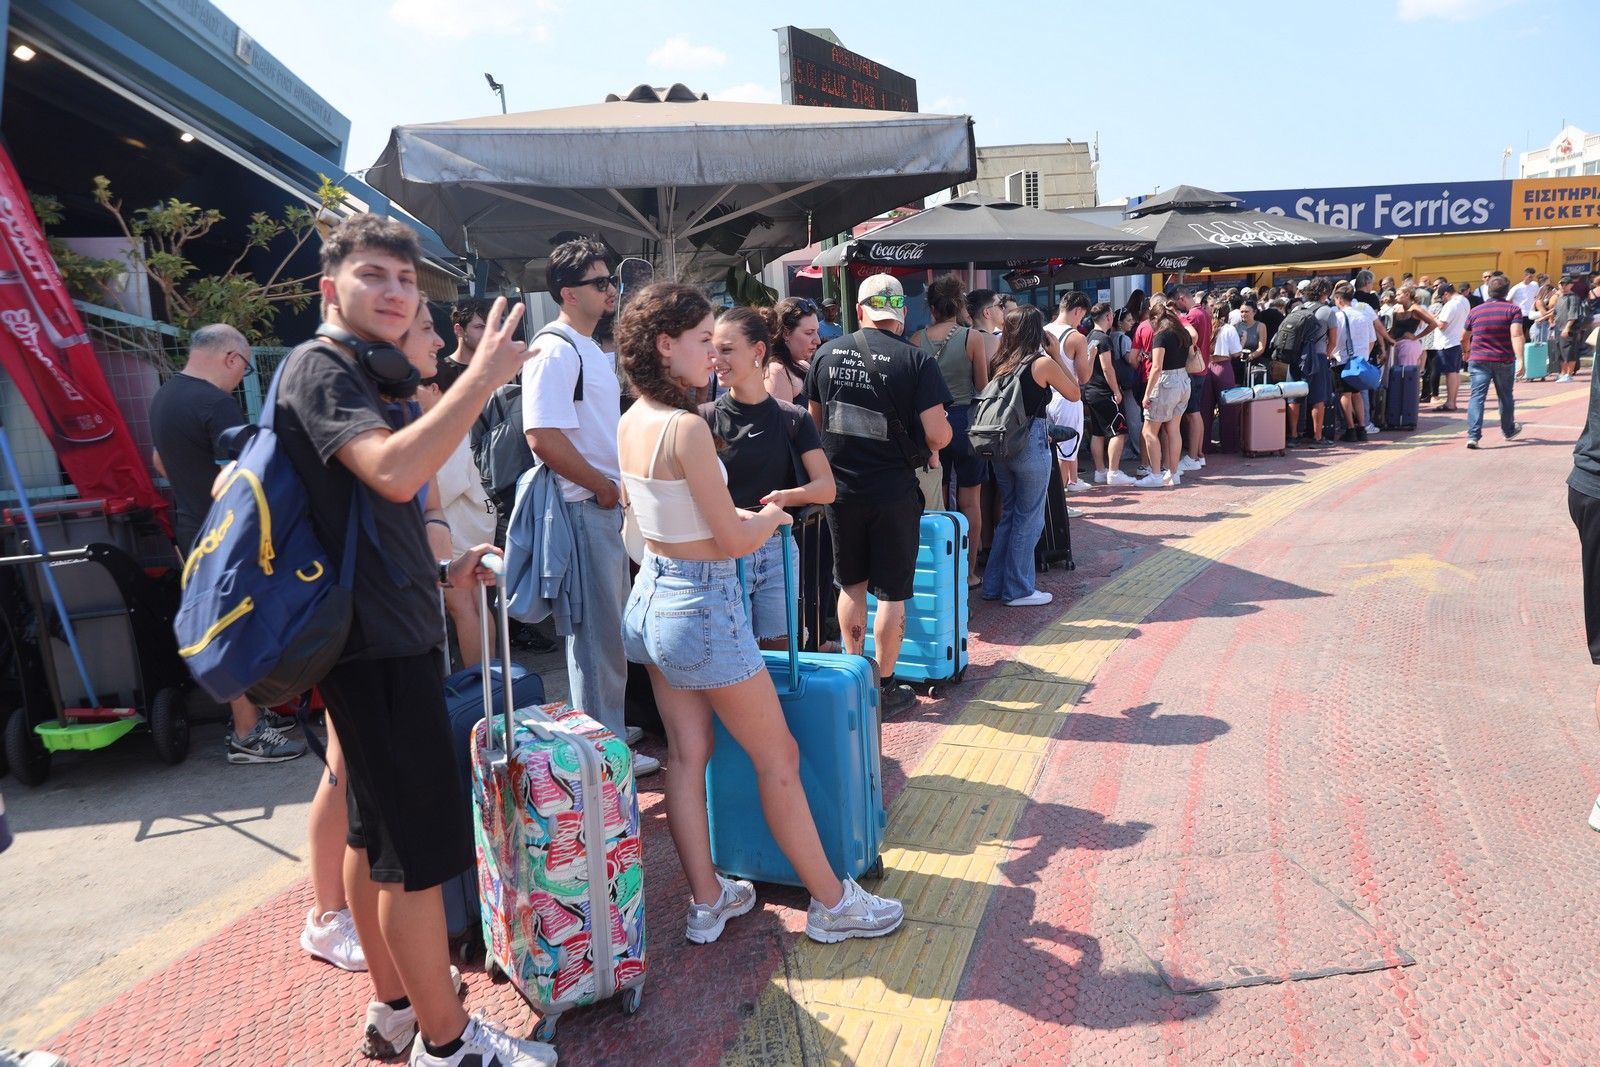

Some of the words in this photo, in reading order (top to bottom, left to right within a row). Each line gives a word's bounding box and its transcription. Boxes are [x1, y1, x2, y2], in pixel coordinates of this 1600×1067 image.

[1296, 196, 1365, 231] Star
[869, 242, 928, 260] Coca-Cola
[842, 358, 856, 366] July
[878, 354, 891, 362] Out
[829, 366, 857, 381] WEST
